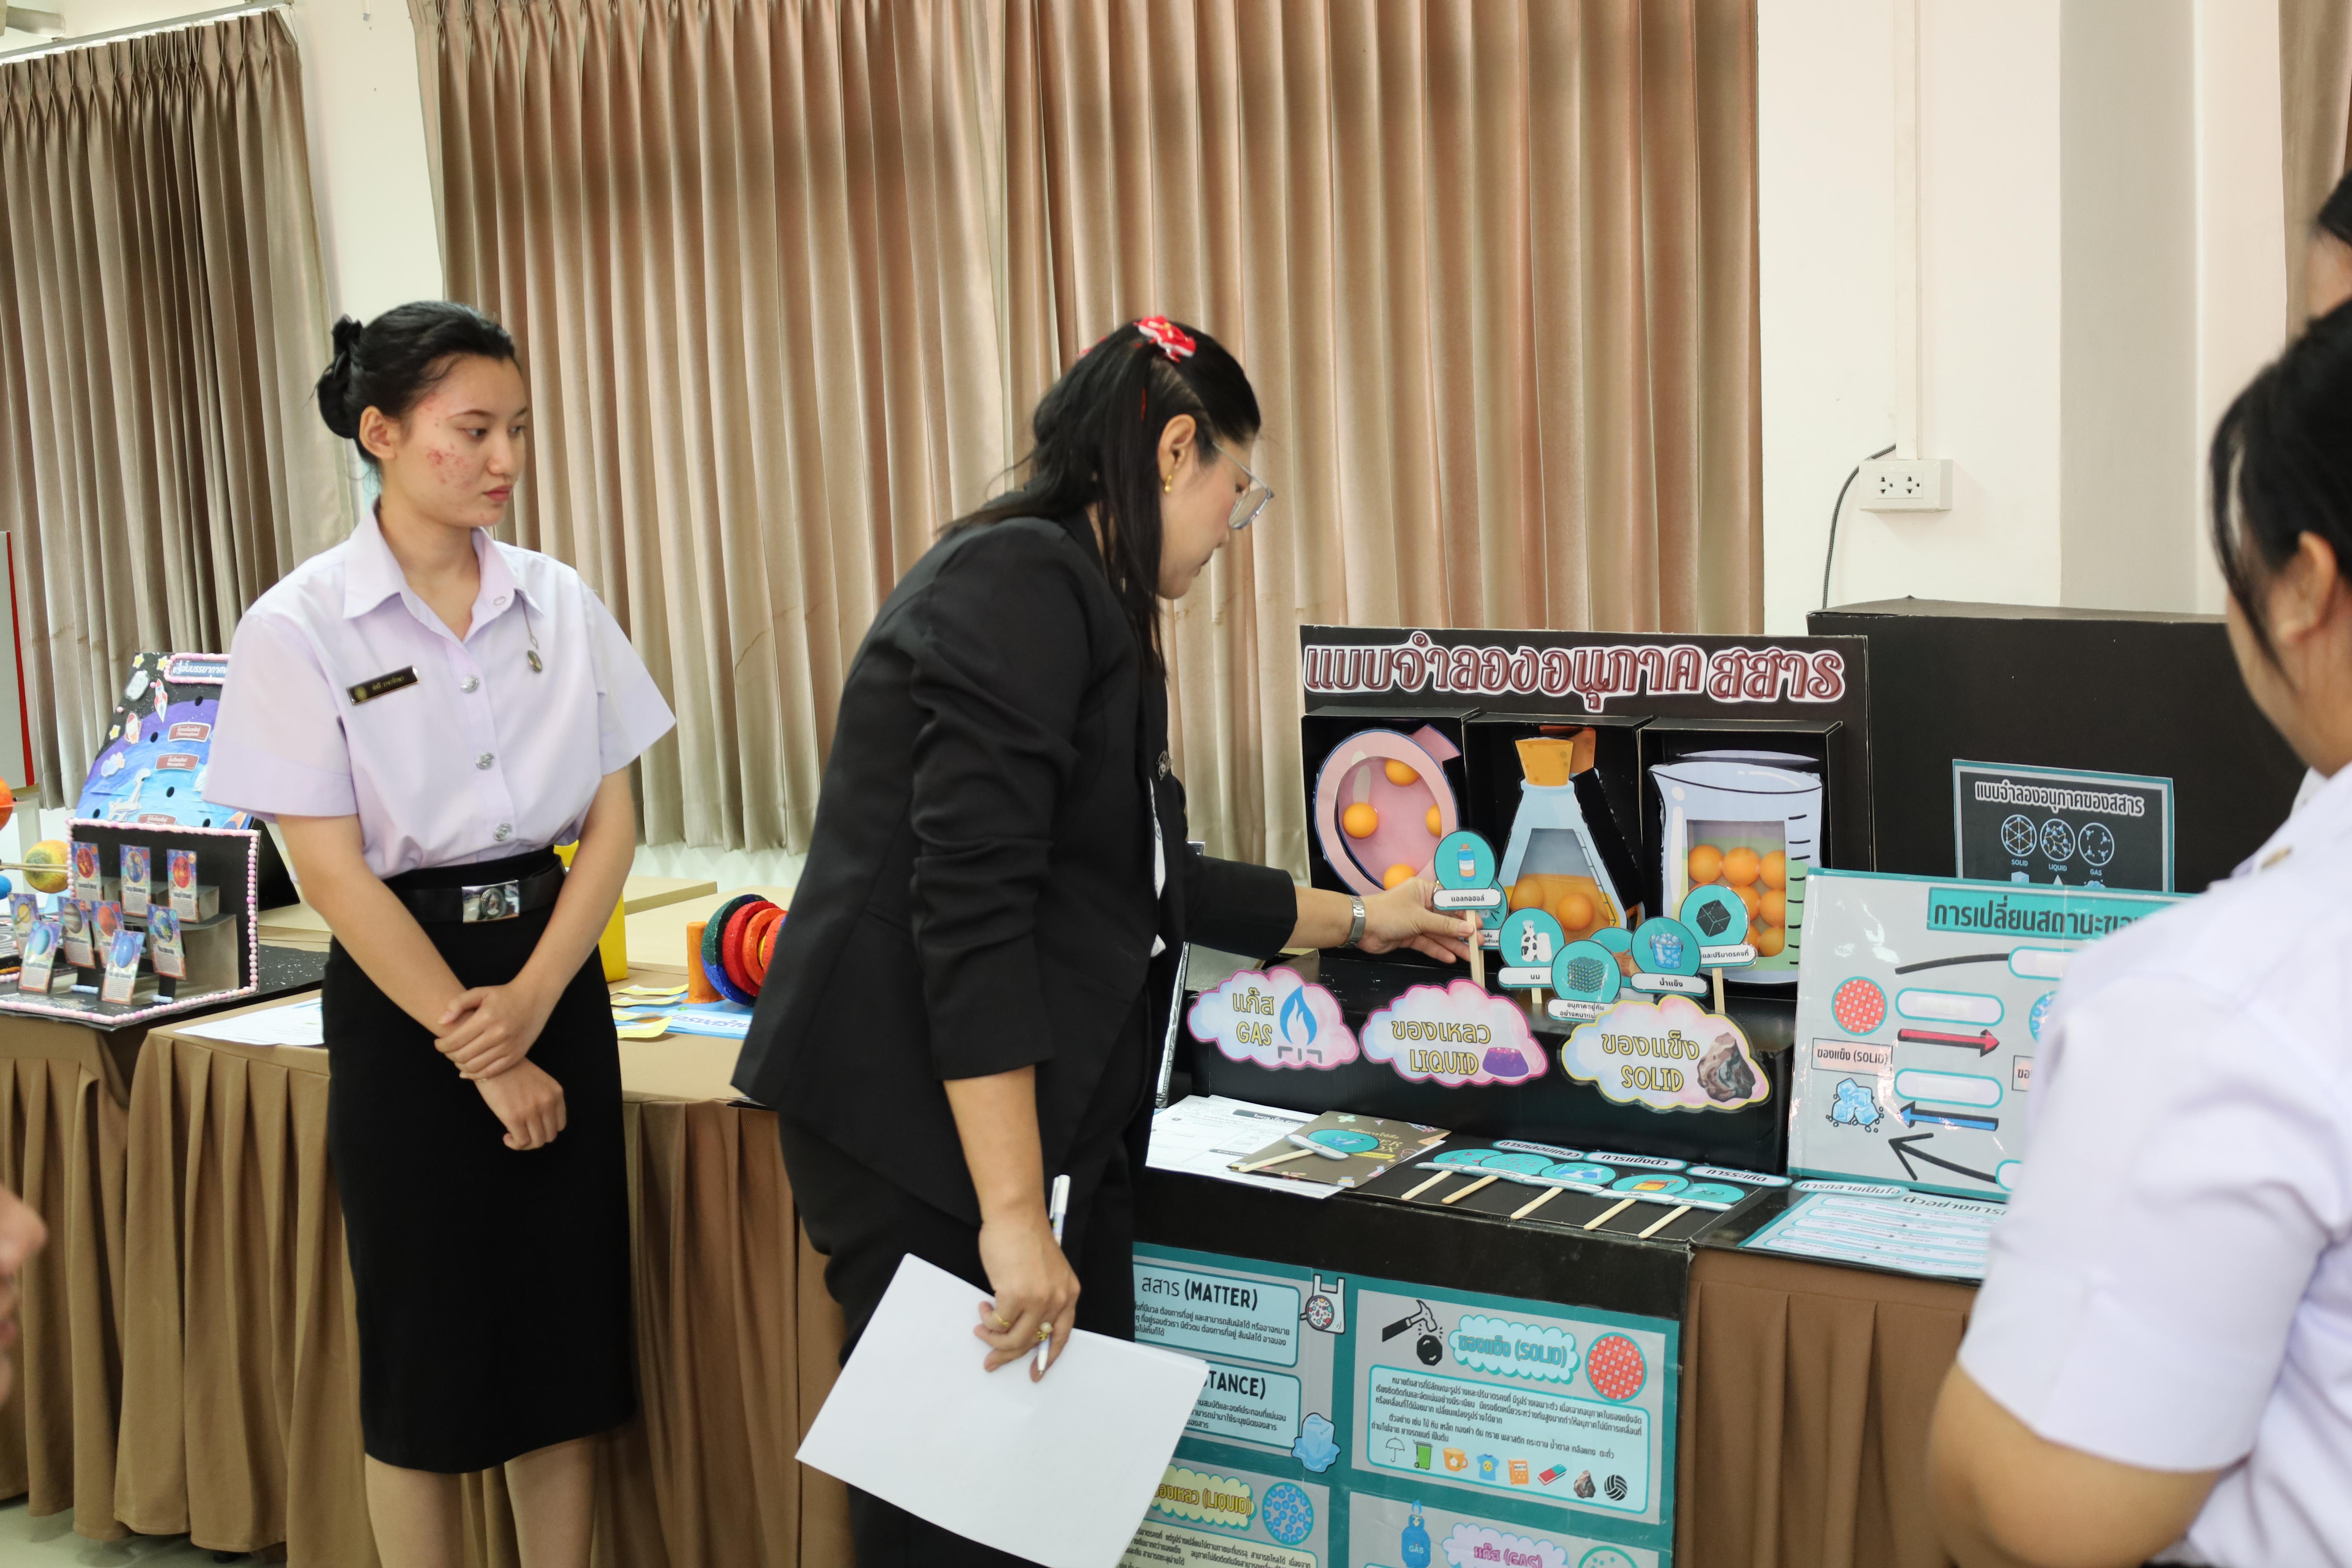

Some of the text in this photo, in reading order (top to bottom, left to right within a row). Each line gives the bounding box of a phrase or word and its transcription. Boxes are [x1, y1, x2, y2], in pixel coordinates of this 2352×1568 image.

[1306, 632, 1842, 710] แบบจำลองอนุภาค สสาร
[1975, 779, 2145, 817] แบบจำลองอนุภาคของสสาร
[1451, 894, 1485, 902] แอลกอฮอล์
[1660, 977, 1683, 988] น้ำแข็ง
[1232, 987, 1274, 1016] แก๊ส
[1567, 1003, 1604, 1011] อนุภาคอยู่กัน
[1236, 1021, 1272, 1046] GAS
[1391, 1020, 1491, 1044] ของเหลว
[1602, 1030, 1700, 1060] ของแข็ง
[1817, 1048, 1888, 1065] ของแข็ง (SOLID)
[1410, 1049, 1479, 1076] LIQUID
[2018, 1069, 2032, 1079] ขอ
[1621, 1065, 1684, 1092] SOLID
[1500, 1142, 1580, 1157] การหลอมเหลว
[1602, 1154, 1669, 1165] การแข็งตัว
[1706, 1170, 1767, 1182] การระเหิด
[1800, 1182, 1901, 1195] การกลายเป็นไอ
[1142, 1277, 1257, 1311] สสาร (MATTER)
[1141, 1313, 1179, 1328] ที่อยู่รอบตัวเรา
[1181, 1321, 1200, 1331] มีตัวตน
[1202, 1324, 1236, 1340] ต้องการที่อยู่
[1238, 1331, 1262, 1342] สัมผัสได้
[1263, 1336, 1286, 1346] อาจมอง
[1160, 1306, 1193, 1321] ต้องการที่อยู่
[1195, 1314, 1250, 1329] และสามารถสัมผัสได้
[1251, 1322, 1290, 1335] หรืออาจหมาย
[1458, 1335, 1567, 1368] ของแข็ง (SOLID)
[1204, 1370, 1265, 1400] TANCE)
[1376, 1395, 1502, 1424] หรือเคลื่อนที่ได้น้อยมาก เปลี่ยนแปลงรูปร่างได้ยาก
[1513, 1395, 1558, 1411] มีรูปร่างเฉพาะตัว
[1371, 1422, 1449, 1442] ถ่านไฟฉาย ยางรถยนต์ เป็นต้น
[1389, 1414, 1410, 1424] ตัวอย่าง
[1412, 1417, 1421, 1426] เช่น
[1440, 1423, 1453, 1431] เหล็ก
[1455, 1425, 1474, 1435] ทองคำ
[1485, 1430, 1499, 1439] ทราย
[1501, 1434, 1525, 1444] พลาสติก
[1526, 1438, 1548, 1448] กระดาษ
[1550, 1439, 1570, 1452] น้ำตาล
[1600, 1448, 1614, 1459] ตะกั่ว
[1202, 1488, 1251, 1517] (LIQUID)
[1409, 1545, 1424, 1554] GAS
[1474, 1543, 1542, 1568] แก๊ส (GAS)
